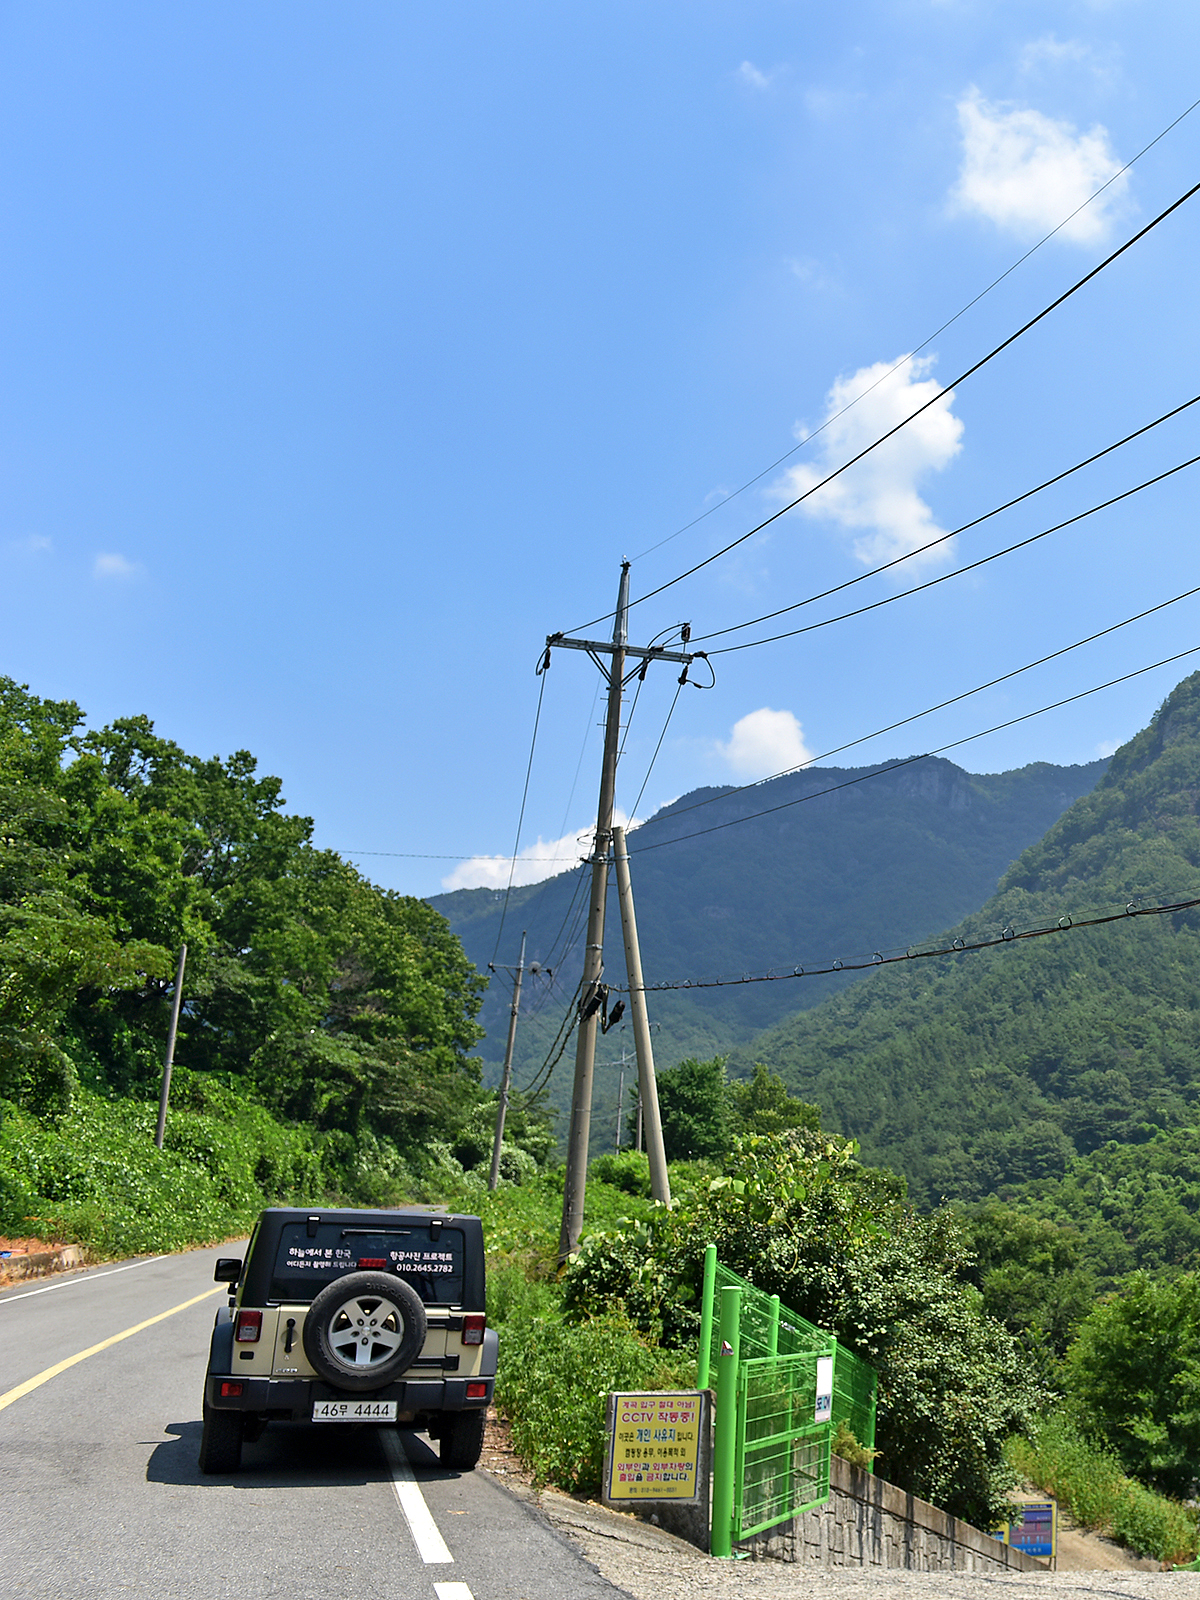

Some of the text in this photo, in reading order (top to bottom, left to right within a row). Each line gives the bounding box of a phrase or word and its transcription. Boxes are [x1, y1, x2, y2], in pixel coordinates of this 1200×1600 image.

[289, 1248, 352, 1259] 하늘에서 본 한국
[390, 1251, 453, 1262] 항공사진 프로젝트
[396, 1264, 453, 1273] 010.2645.2782
[321, 1404, 389, 1416] 46무 4444
[640, 1401, 656, 1409] 입구
[621, 1412, 695, 1423] CCTV 작동중!
[636, 1428, 651, 1442] 개인
[653, 1428, 676, 1442] 사유지
[617, 1463, 650, 1471] 외부인과
[619, 1473, 643, 1482] 출입을
